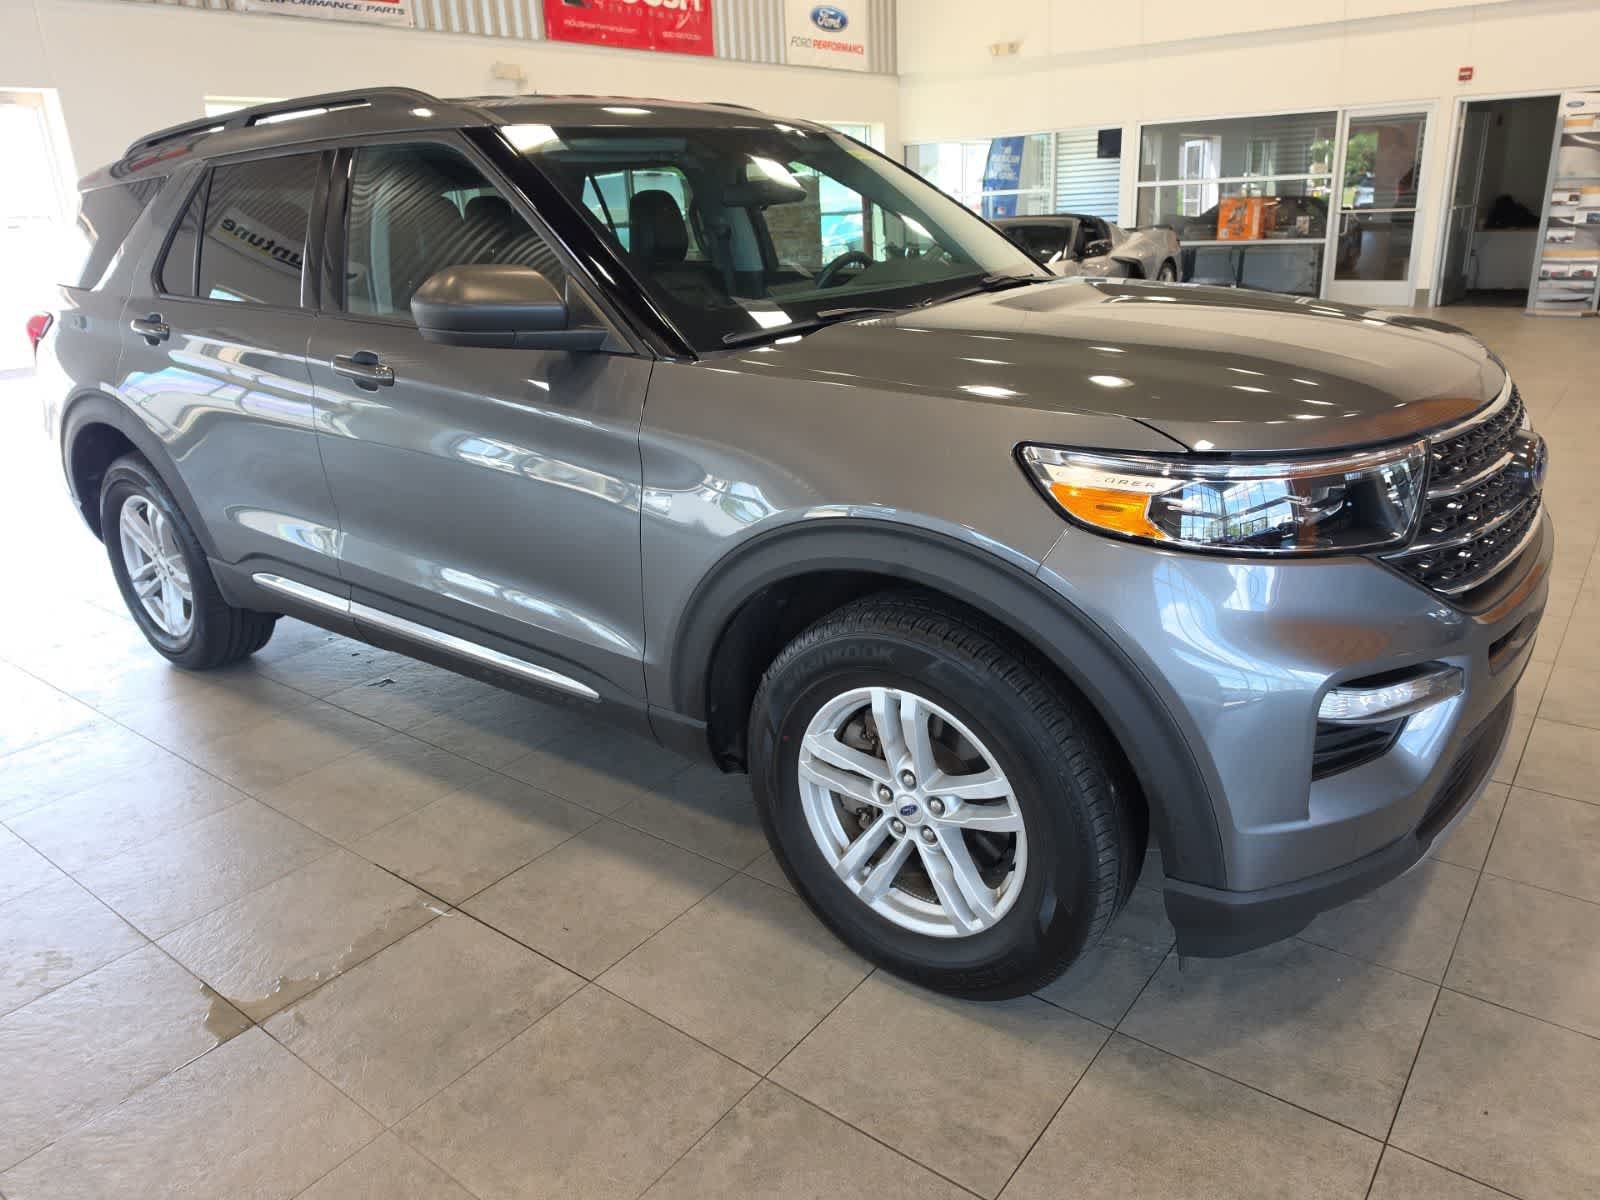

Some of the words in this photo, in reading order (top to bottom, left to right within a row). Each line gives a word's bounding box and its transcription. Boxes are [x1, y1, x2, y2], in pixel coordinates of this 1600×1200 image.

[258, 0, 362, 11] FORMANCE
[366, 6, 405, 15] PARTS
[791, 36, 811, 48] FORD
